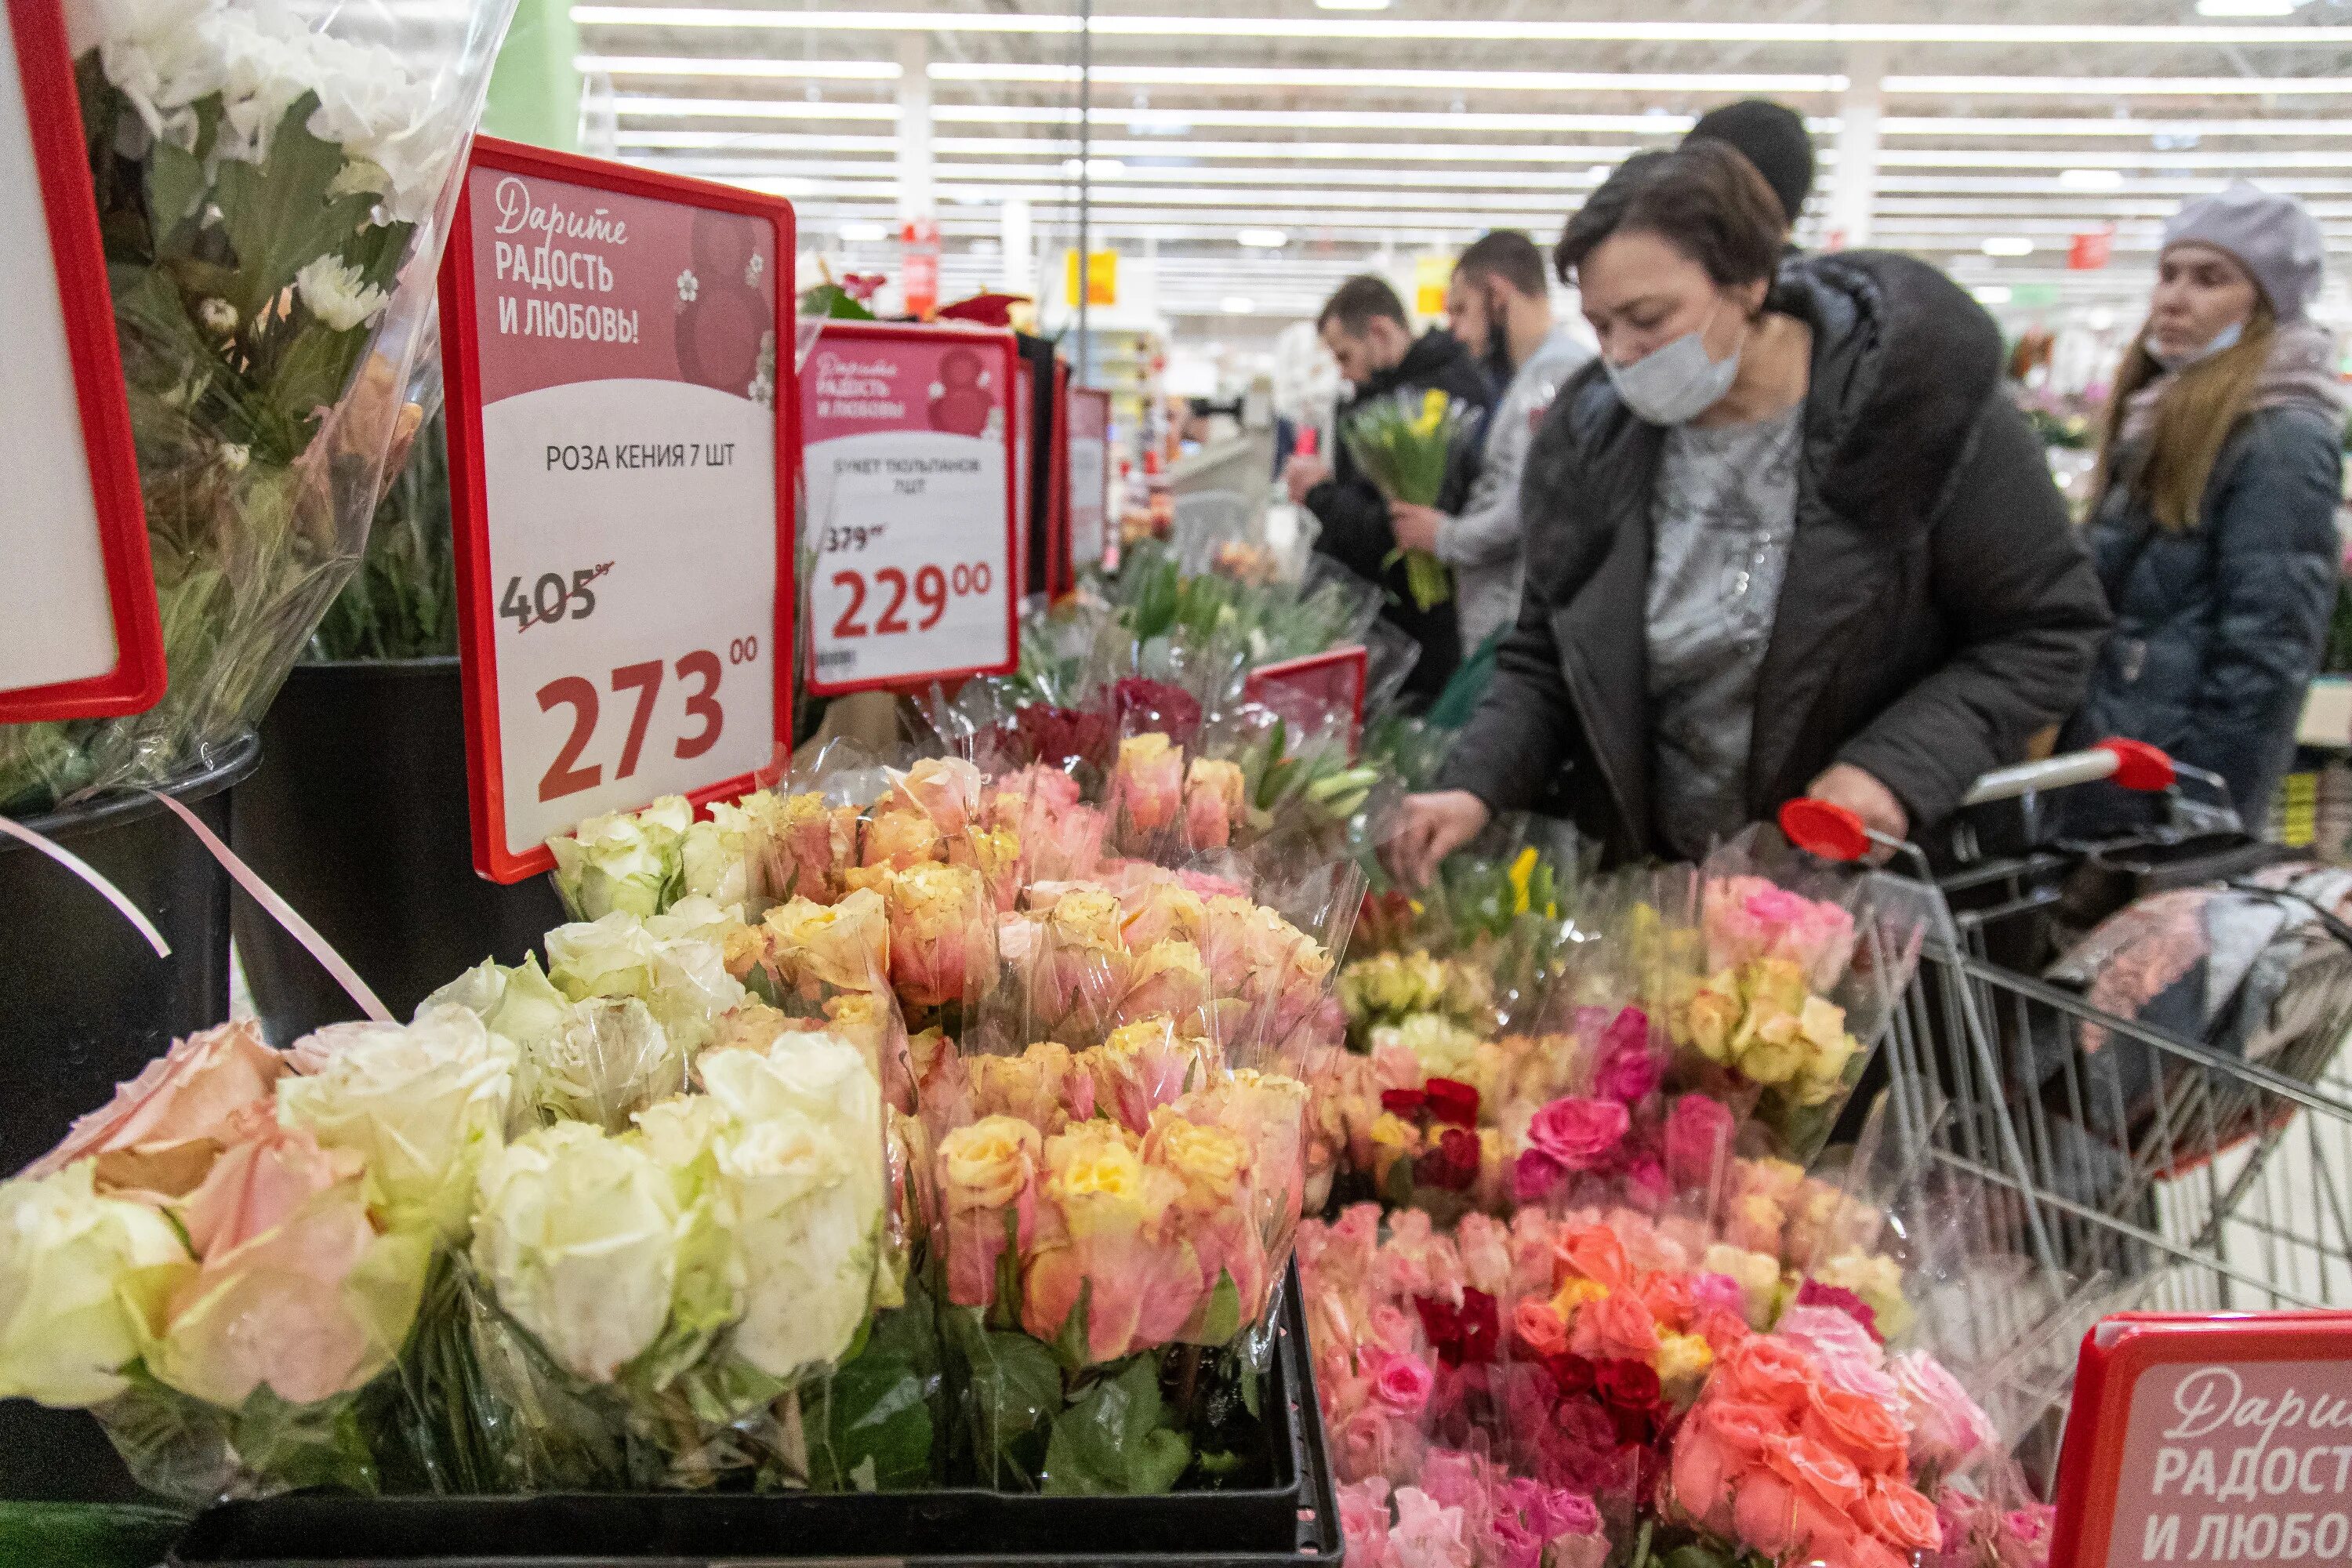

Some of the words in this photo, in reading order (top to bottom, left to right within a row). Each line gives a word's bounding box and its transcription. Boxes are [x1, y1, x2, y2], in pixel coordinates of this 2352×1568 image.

[495, 176, 628, 249] Дарите
[495, 241, 615, 292] РАДОСТЬ
[498, 296, 519, 336] И
[524, 299, 639, 345] ЛЮБОВЬ!
[546, 445, 610, 471] РОЗА
[615, 443, 685, 470] КЕНИЯ
[690, 443, 701, 467] 7
[706, 442, 735, 466] ШТ
[831, 563, 948, 639] 229
[952, 561, 992, 597] 00
[535, 649, 724, 803] 273
[730, 636, 758, 665] 00
[2152, 1446, 2352, 1503] РАДОСТ
[2142, 1514, 2181, 1561] И
[2187, 1513, 2352, 1561] ЛЮБО
